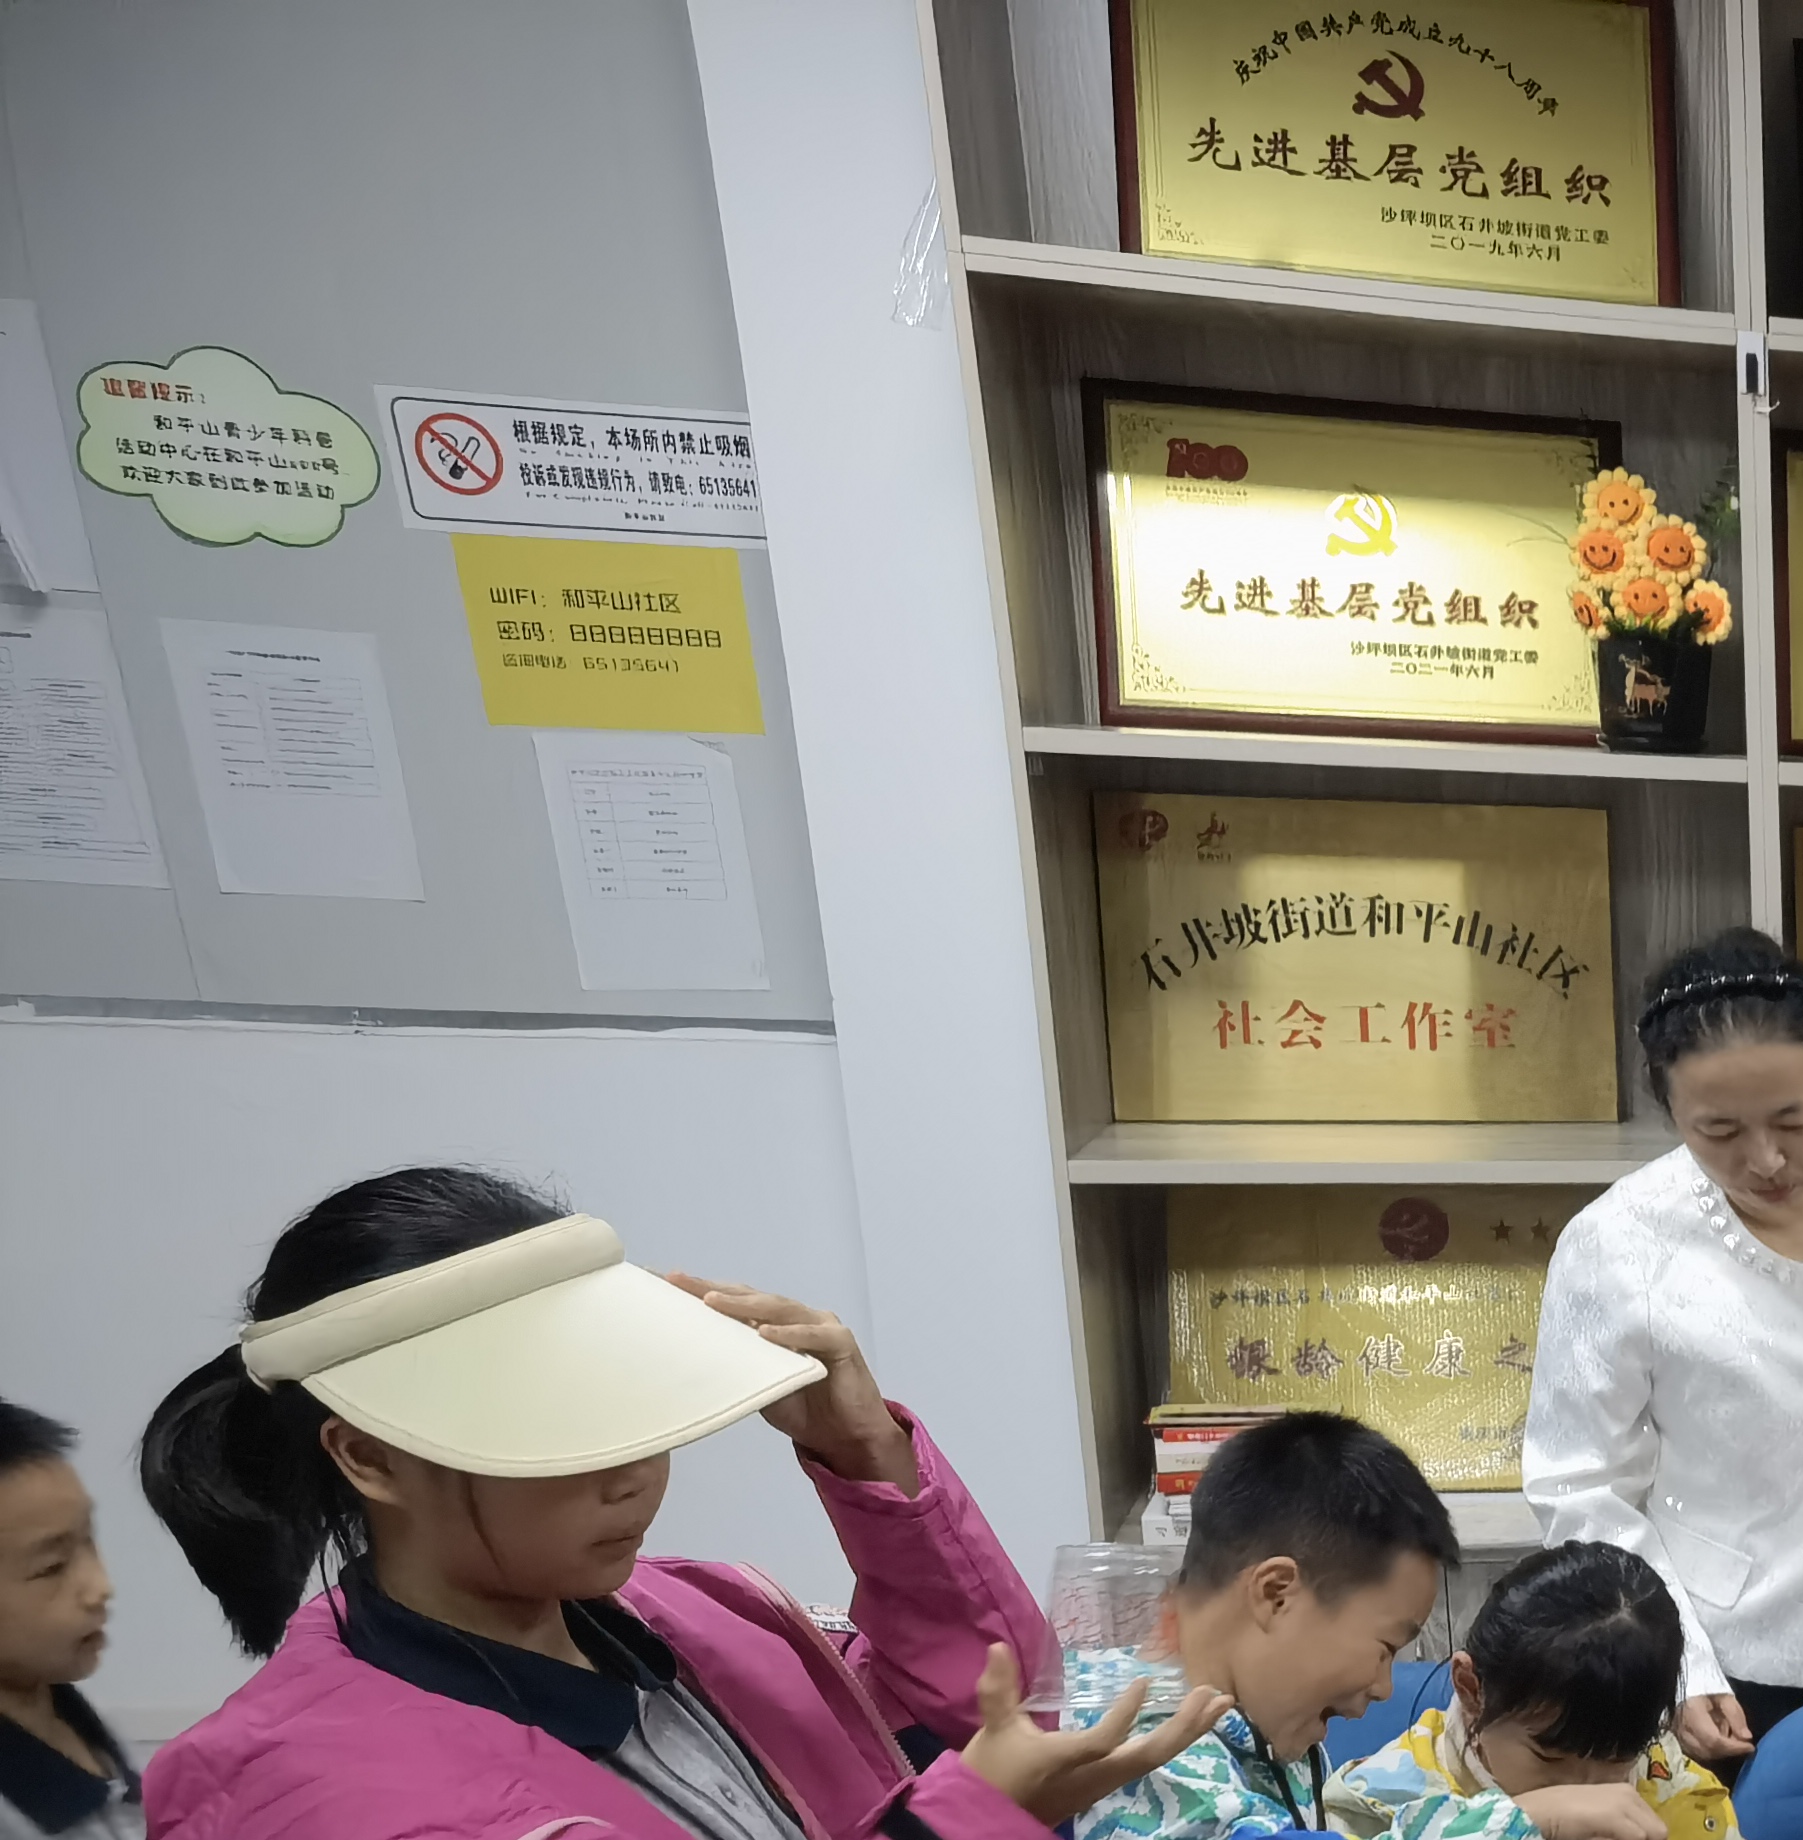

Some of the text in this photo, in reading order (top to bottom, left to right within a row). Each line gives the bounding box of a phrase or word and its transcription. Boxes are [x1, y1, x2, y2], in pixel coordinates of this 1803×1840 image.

[1234, 9, 1560, 118] 庆祝中国共产党成立九十八周年
[1187, 117, 1613, 208] 先进基层党组织
[1180, 567, 1541, 631] 先进基层党组织
[1131, 890, 1591, 1001] 石井坡街道和平山社区
[1213, 999, 1517, 1052] 社会工作室
